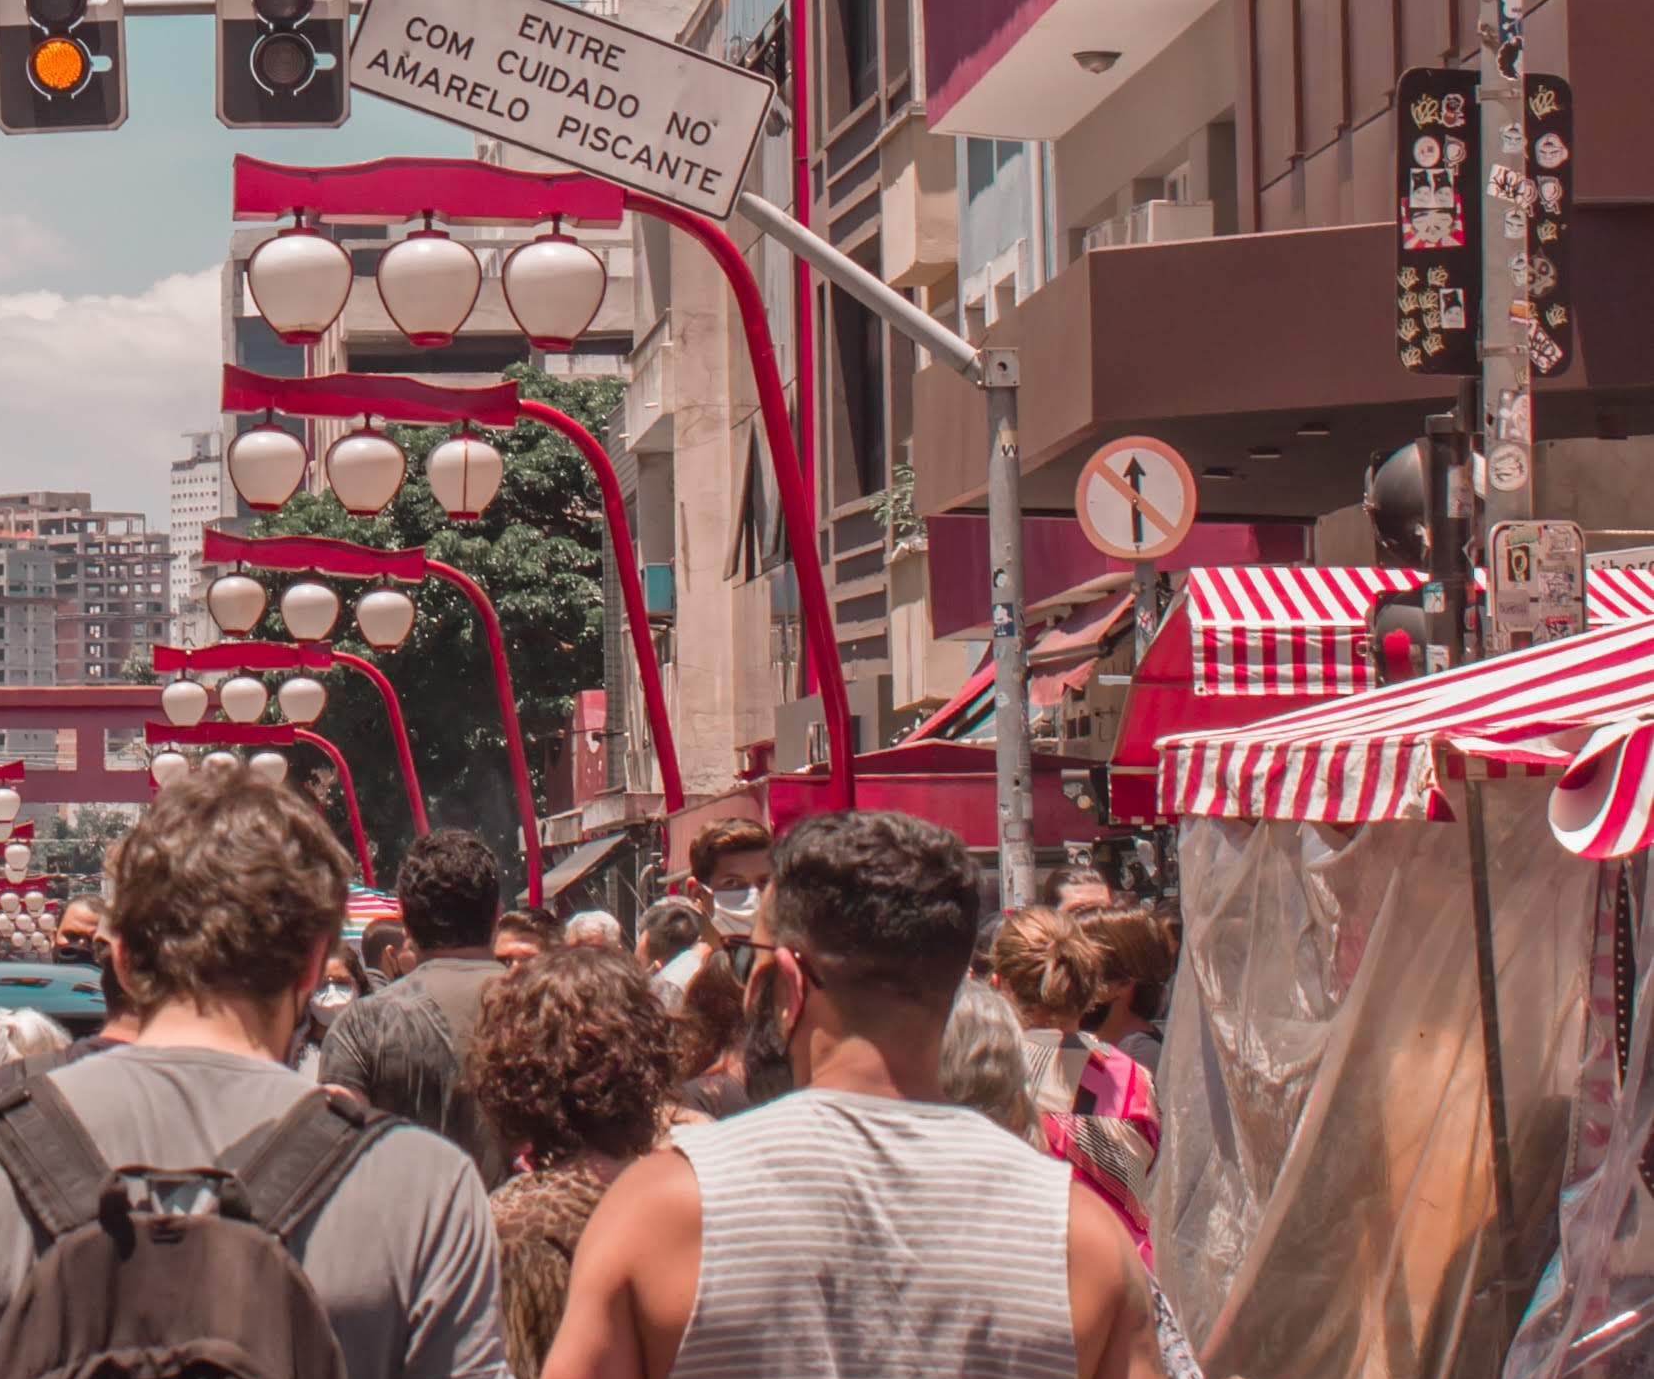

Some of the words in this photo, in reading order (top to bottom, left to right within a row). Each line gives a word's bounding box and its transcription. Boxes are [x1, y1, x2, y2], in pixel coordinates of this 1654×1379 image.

[405, 16, 475, 60] COM
[498, 49, 639, 119] CUIDADO
[666, 111, 712, 146] NO
[518, 13, 626, 72] ENTRE
[366, 49, 530, 122] AMARELO
[557, 115, 722, 195] PISCANTE
